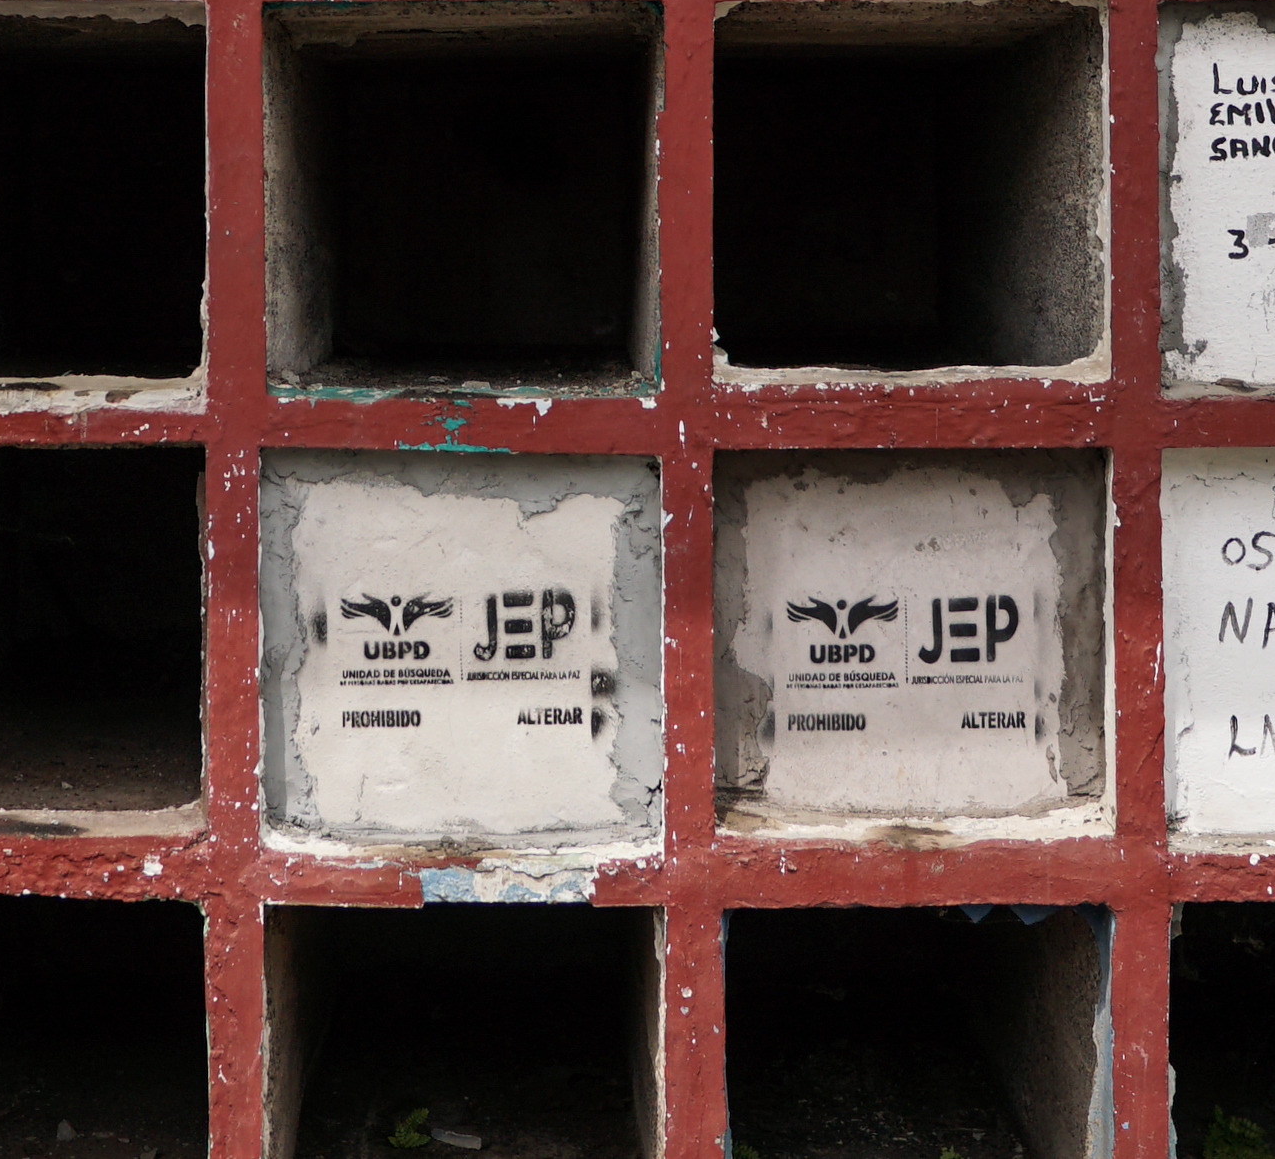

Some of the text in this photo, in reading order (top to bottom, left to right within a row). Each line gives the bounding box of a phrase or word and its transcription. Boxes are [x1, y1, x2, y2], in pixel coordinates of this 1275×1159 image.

[473, 588, 576, 661] JEP
[918, 595, 1019, 664] JEP
[363, 640, 430, 660] UBPD
[809, 644, 875, 663] UBPD
[342, 670, 380, 679] UNIDAD
[383, 670, 395, 678] DE
[788, 673, 826, 682] UNIDAD
[828, 673, 840, 682] DE
[342, 708, 583, 728] PROHIBIDO ALTERAR
[787, 711, 1026, 732] PROHIBIDO ALTERAR
